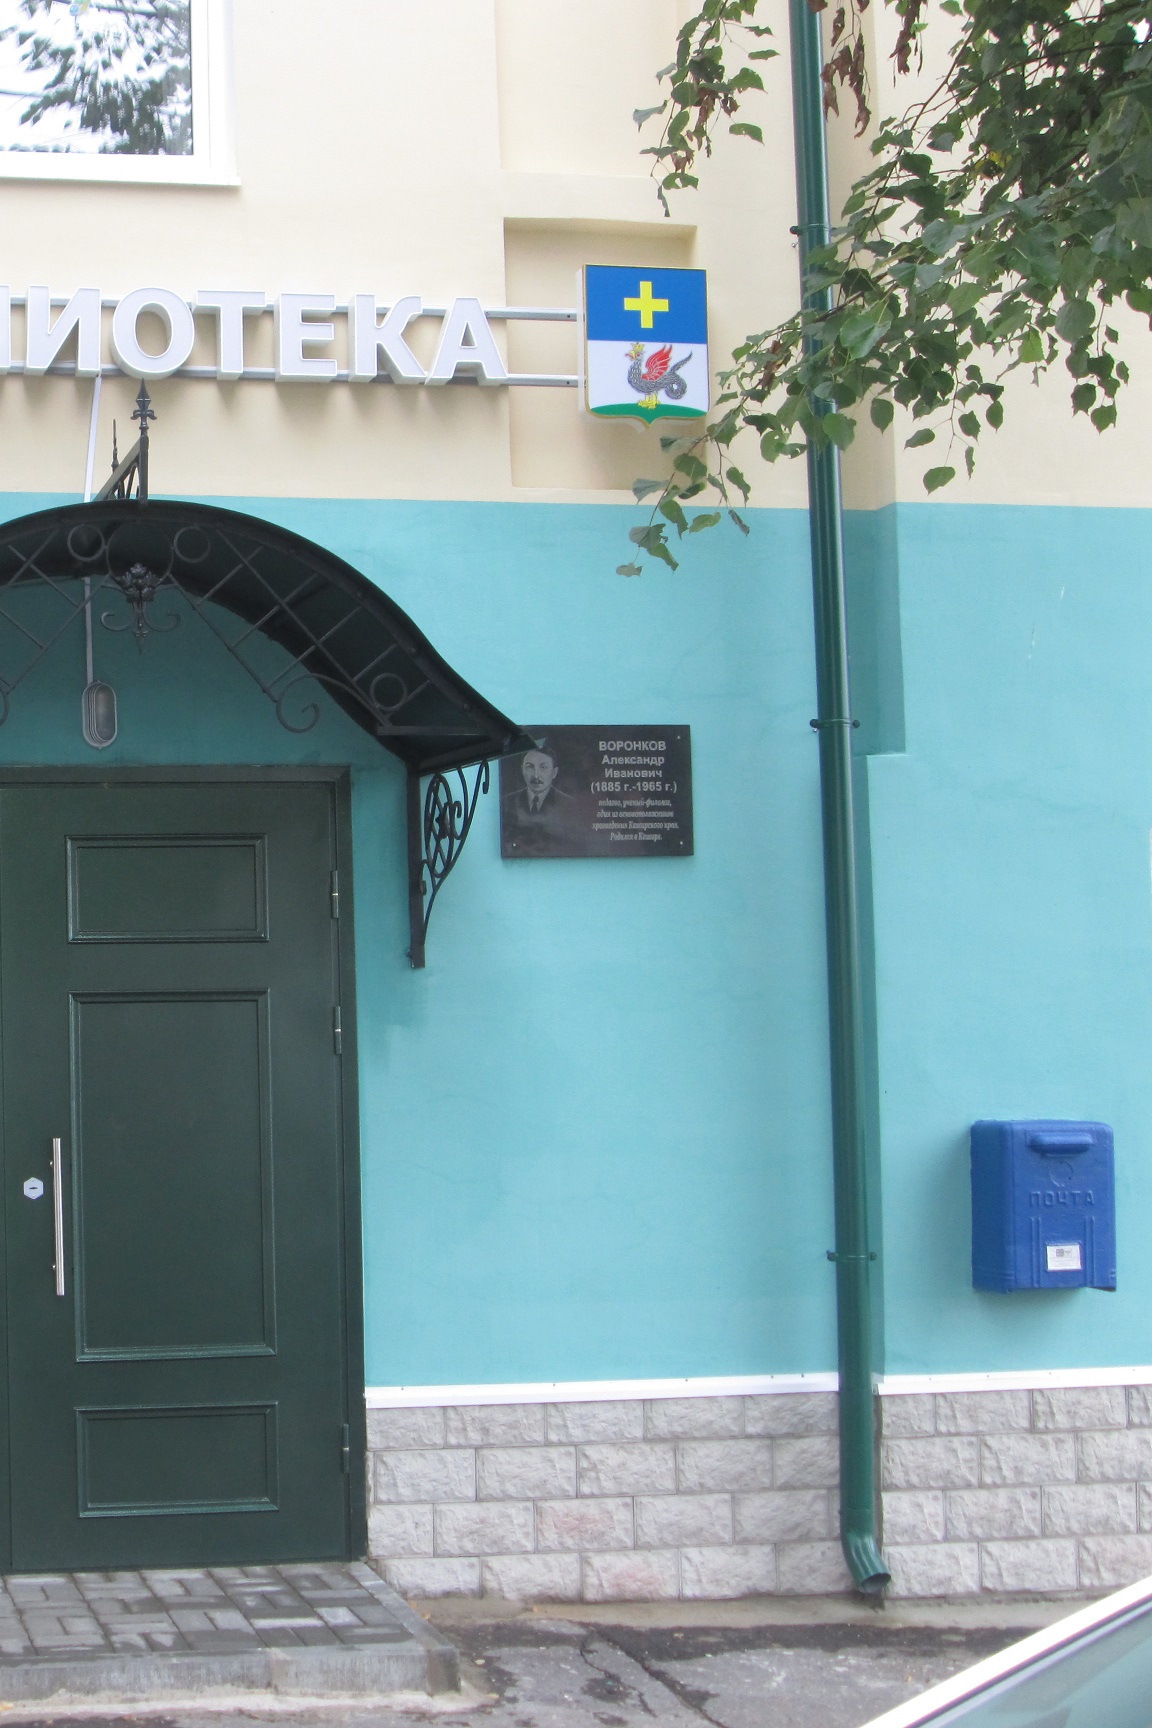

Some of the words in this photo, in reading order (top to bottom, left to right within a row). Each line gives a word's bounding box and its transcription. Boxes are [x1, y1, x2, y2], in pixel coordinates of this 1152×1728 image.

[599, 741, 667, 751] ВОРОНКОВ
[602, 755, 665, 766] Александр
[605, 769, 662, 778] Иванович
[590, 782, 620, 794] (1885
[624, 782, 662, 792] г.-1965
[665, 782, 677, 793] г.)
[1029, 1190, 1095, 1208] ПОЧТА
